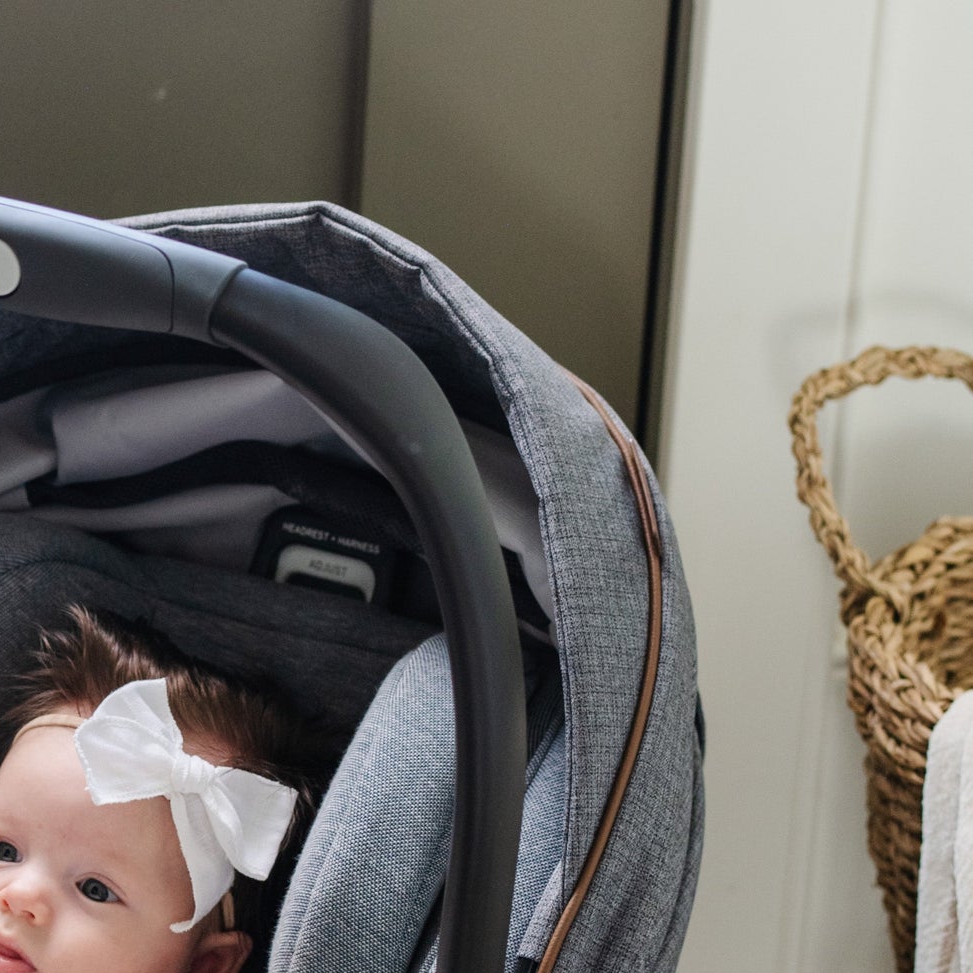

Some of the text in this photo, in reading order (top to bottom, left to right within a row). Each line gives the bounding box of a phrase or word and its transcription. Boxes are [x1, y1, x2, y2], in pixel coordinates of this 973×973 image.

[282, 522, 380, 555] HEADREST HARNESS
[308, 559, 347, 578] ADJUST
